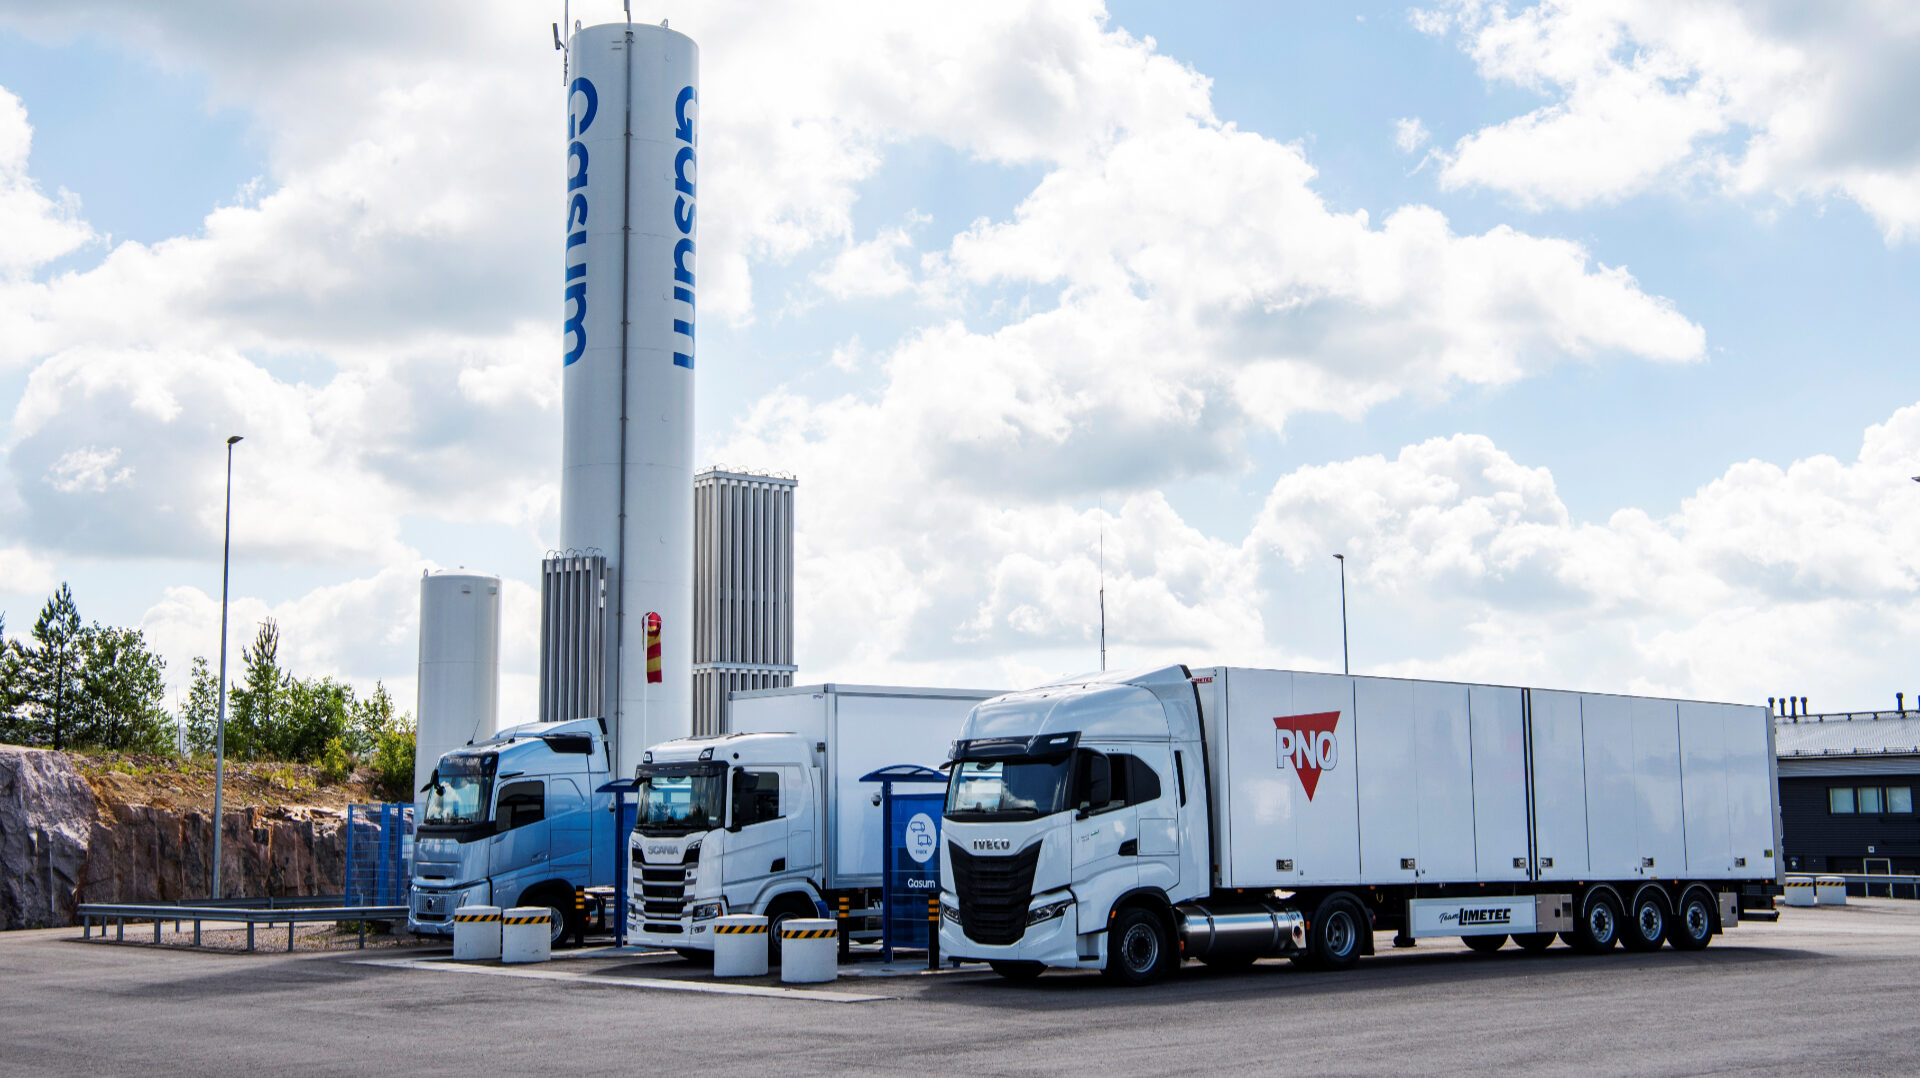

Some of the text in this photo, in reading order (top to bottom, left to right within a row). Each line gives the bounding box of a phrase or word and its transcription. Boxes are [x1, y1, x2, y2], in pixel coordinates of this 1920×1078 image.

[563, 77, 598, 367] Gasum
[673, 86, 697, 370] Gasum
[1276, 728, 1338, 771] PNO
[648, 845, 679, 855] SCANIA
[974, 839, 1010, 850] IVECO
[907, 878, 936, 889] Gasum
[1439, 908, 1511, 925] Team LIMETEC
